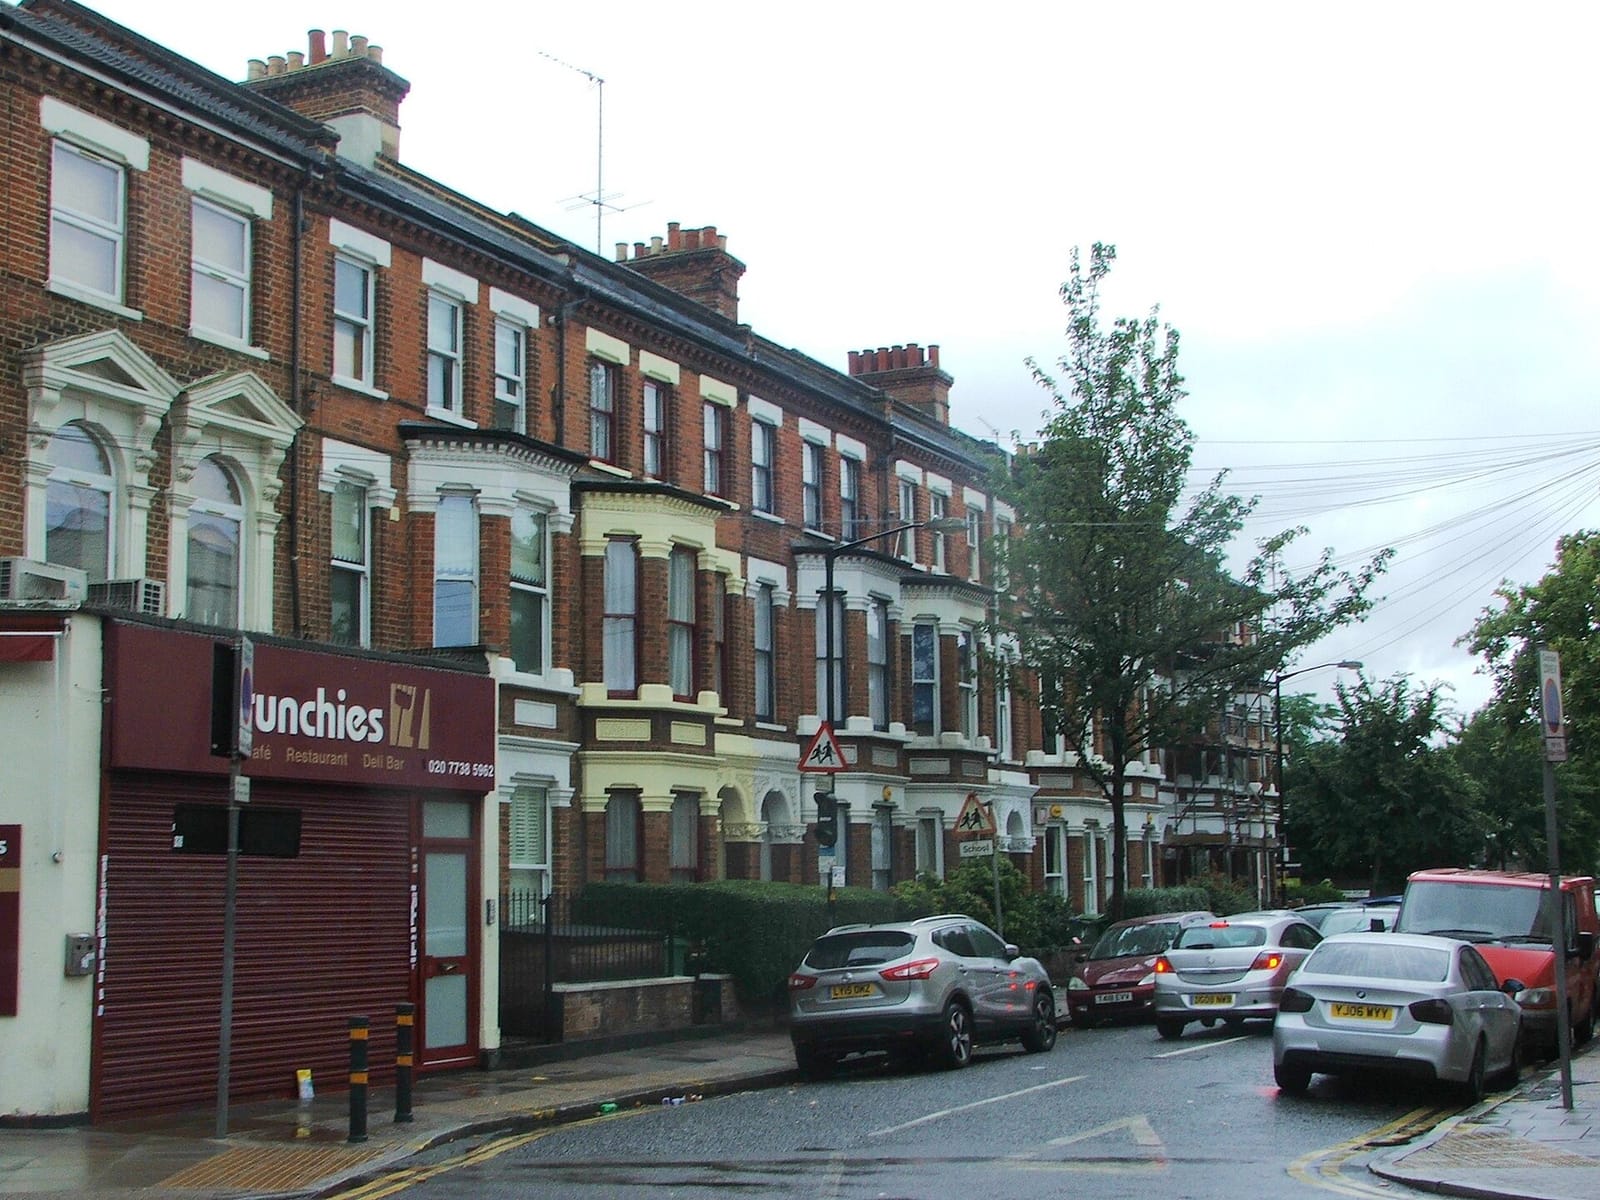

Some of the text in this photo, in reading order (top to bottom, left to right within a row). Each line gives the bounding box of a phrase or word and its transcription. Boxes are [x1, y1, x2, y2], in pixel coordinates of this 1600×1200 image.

[251, 687, 384, 743] unchies
[252, 744, 405, 770] afé Restaurant Deli Bar
[428, 760, 446, 774] 020
[1336, 1004, 1364, 1017] YJ06
